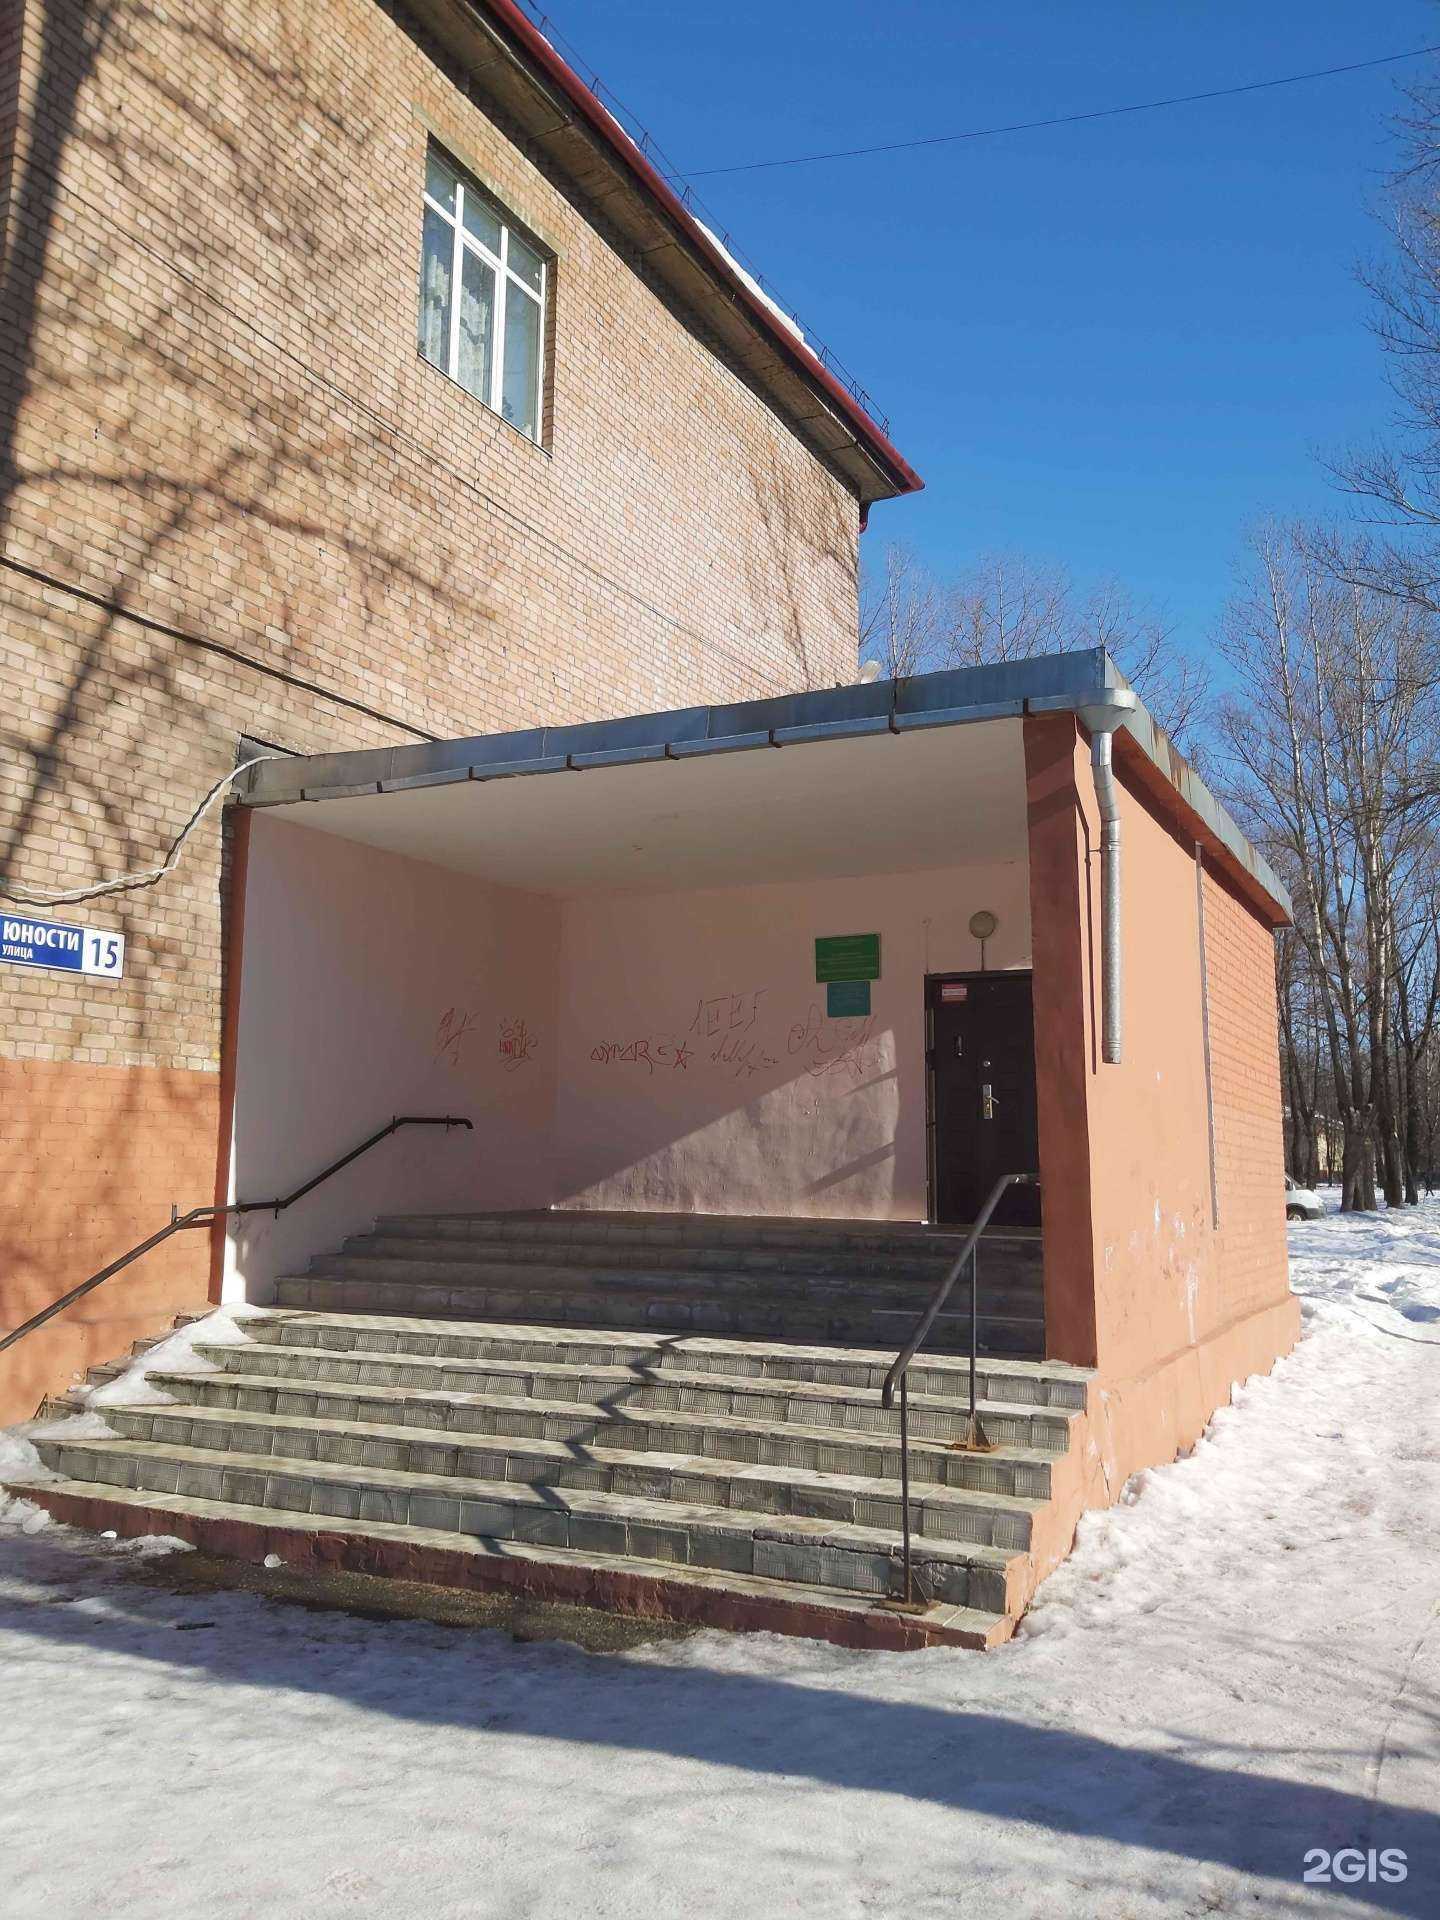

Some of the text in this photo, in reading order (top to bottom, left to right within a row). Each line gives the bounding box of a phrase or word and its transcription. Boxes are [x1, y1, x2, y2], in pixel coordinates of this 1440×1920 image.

[3, 921, 80, 951] ЮНОСТИ
[2, 944, 33, 960] УЛИЦА
[91, 938, 118, 969] 15
